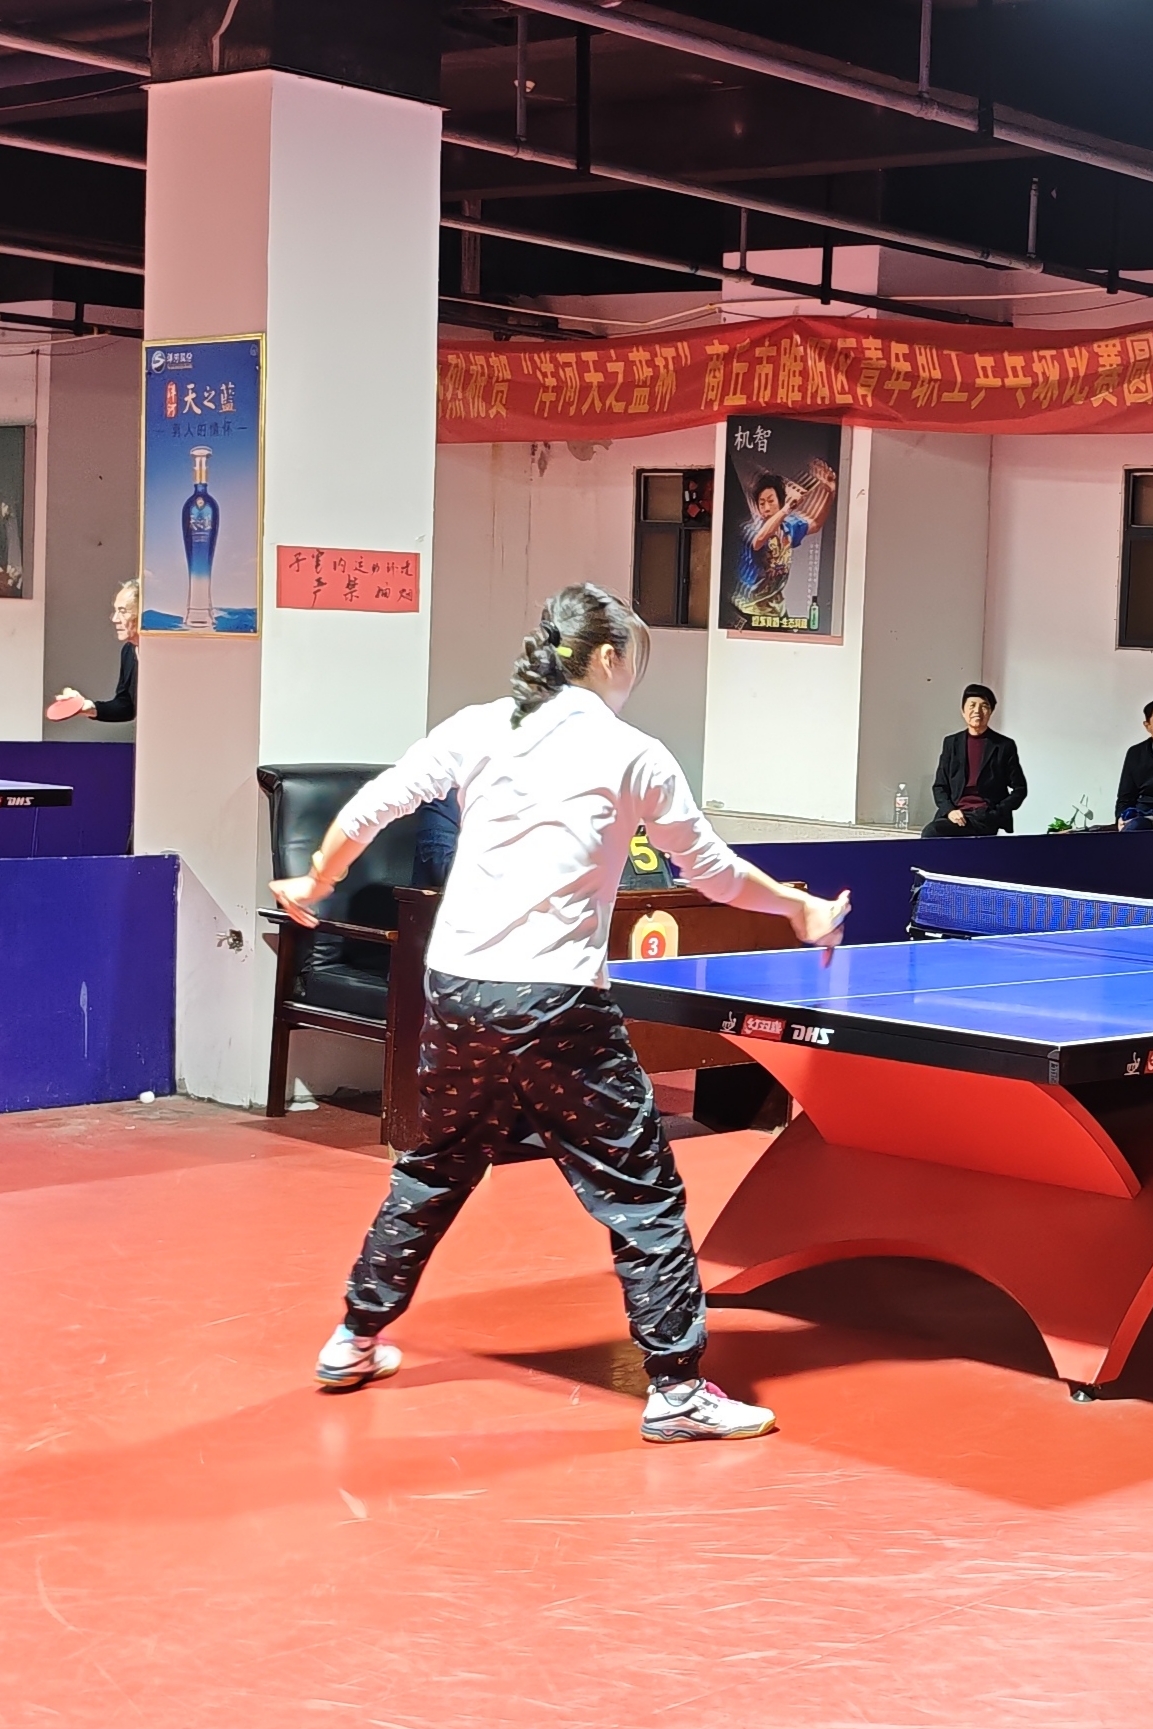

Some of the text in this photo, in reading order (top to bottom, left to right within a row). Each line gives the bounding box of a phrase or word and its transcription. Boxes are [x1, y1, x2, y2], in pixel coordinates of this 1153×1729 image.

[734, 425, 772, 453] 机智
[629, 835, 659, 872] 5
[647, 937, 659, 956] 3
[790, 1024, 835, 1045] DHS
